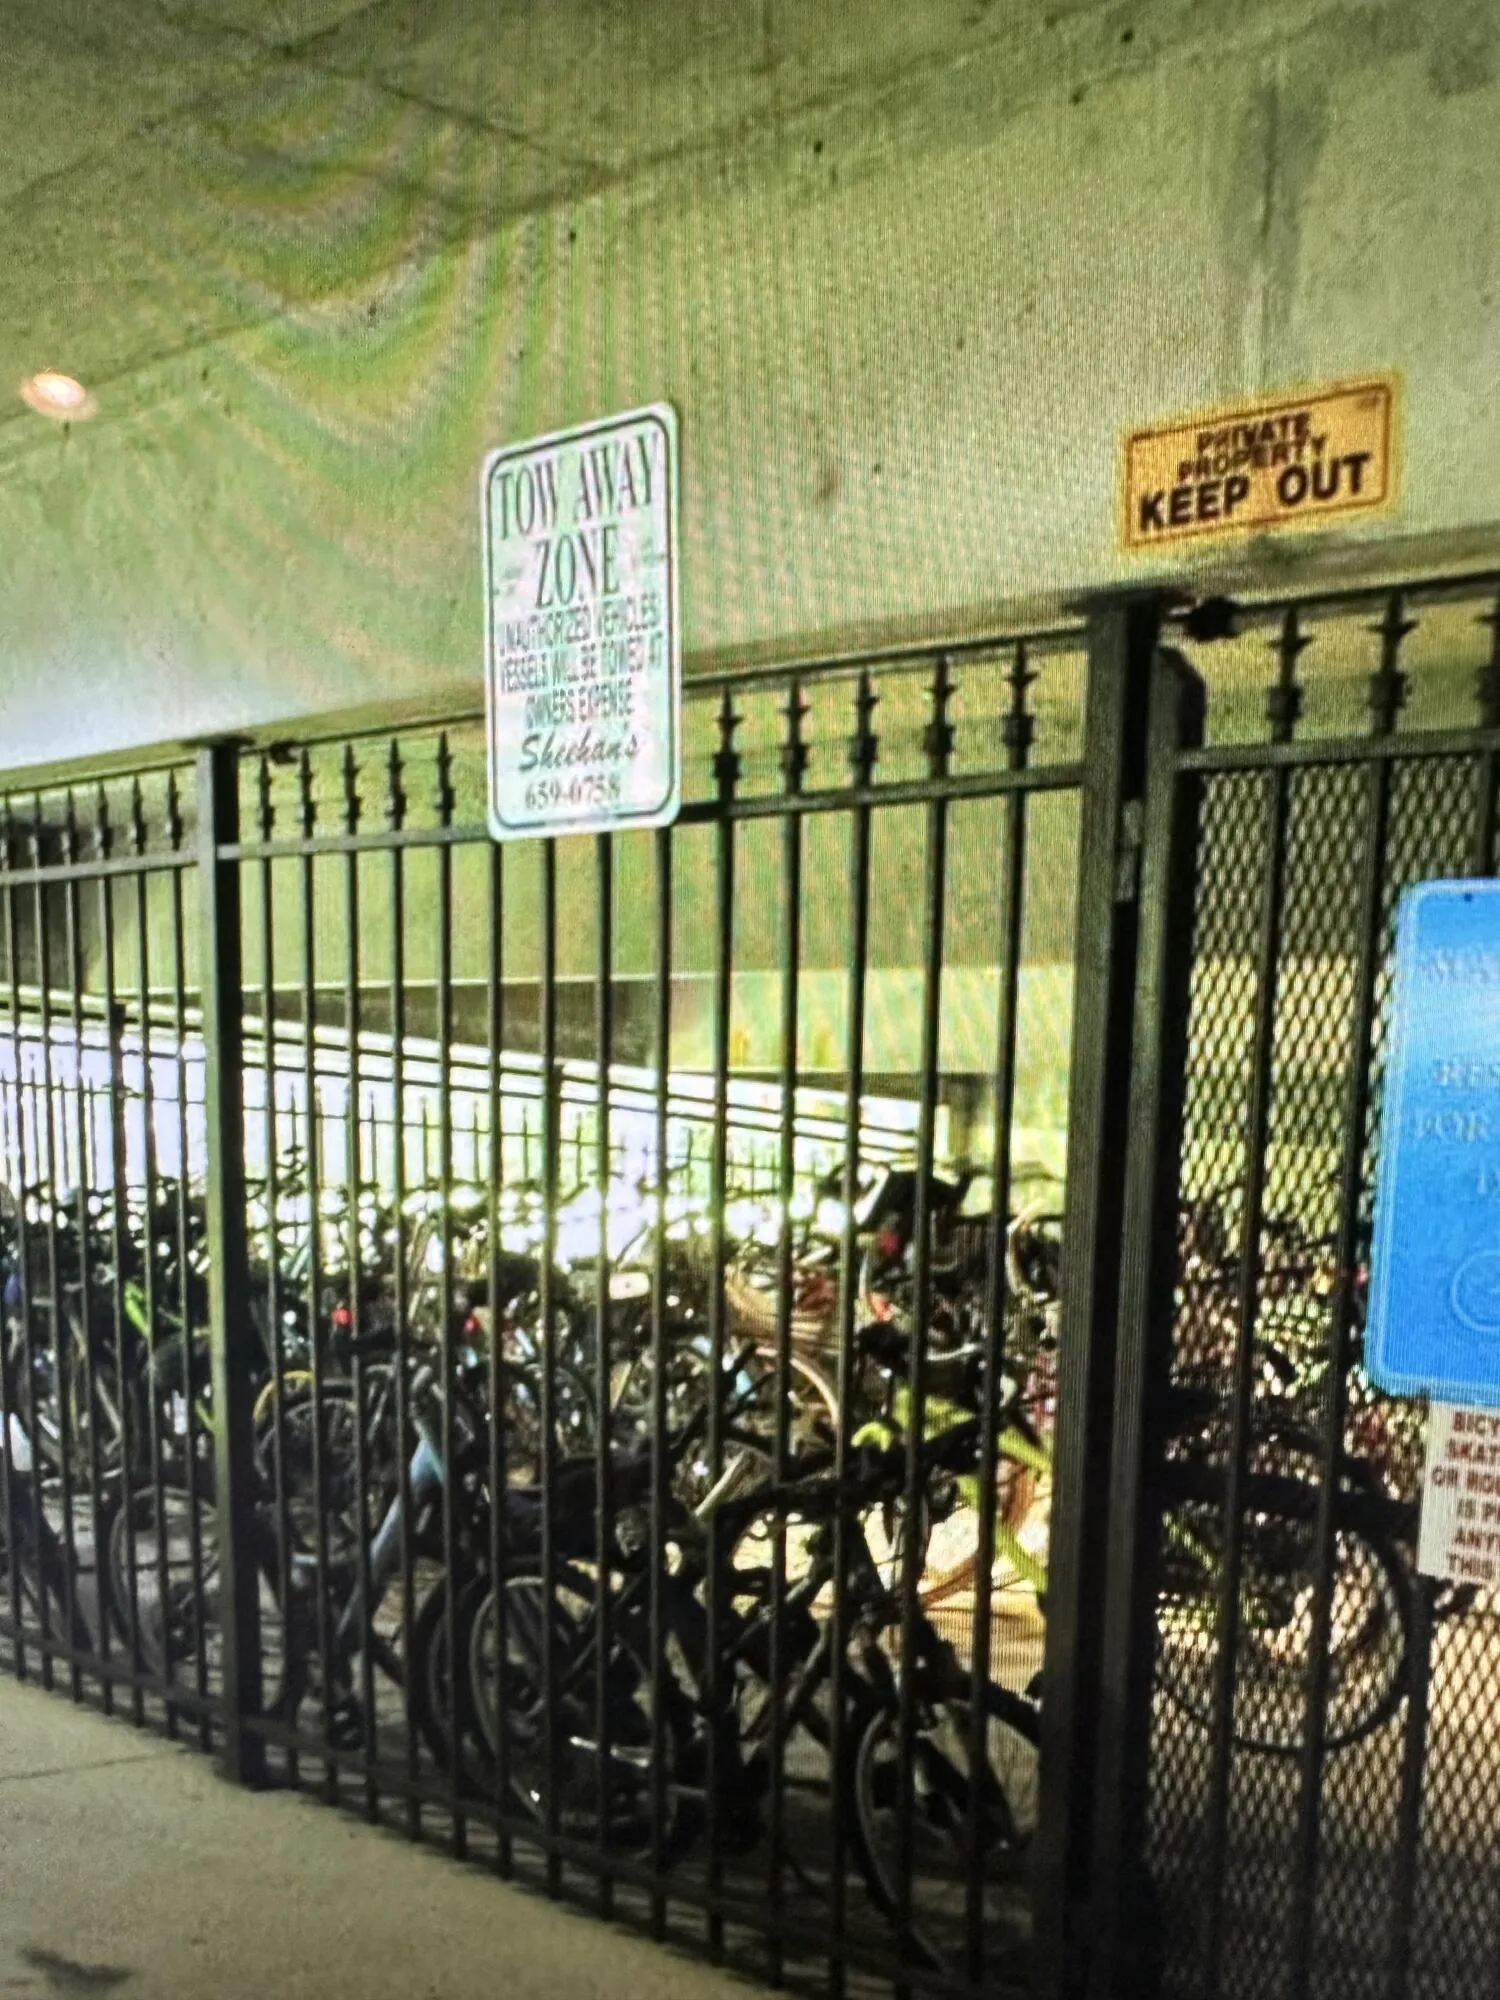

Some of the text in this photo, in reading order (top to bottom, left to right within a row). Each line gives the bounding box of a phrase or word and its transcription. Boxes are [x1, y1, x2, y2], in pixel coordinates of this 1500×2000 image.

[1177, 433, 1327, 481] PROPERTY
[1197, 411, 1310, 452] PRIVATE
[498, 431, 658, 540] TOW AWAY
[1139, 452, 1372, 532] KEEP OUT
[535, 526, 619, 609] ZONE
